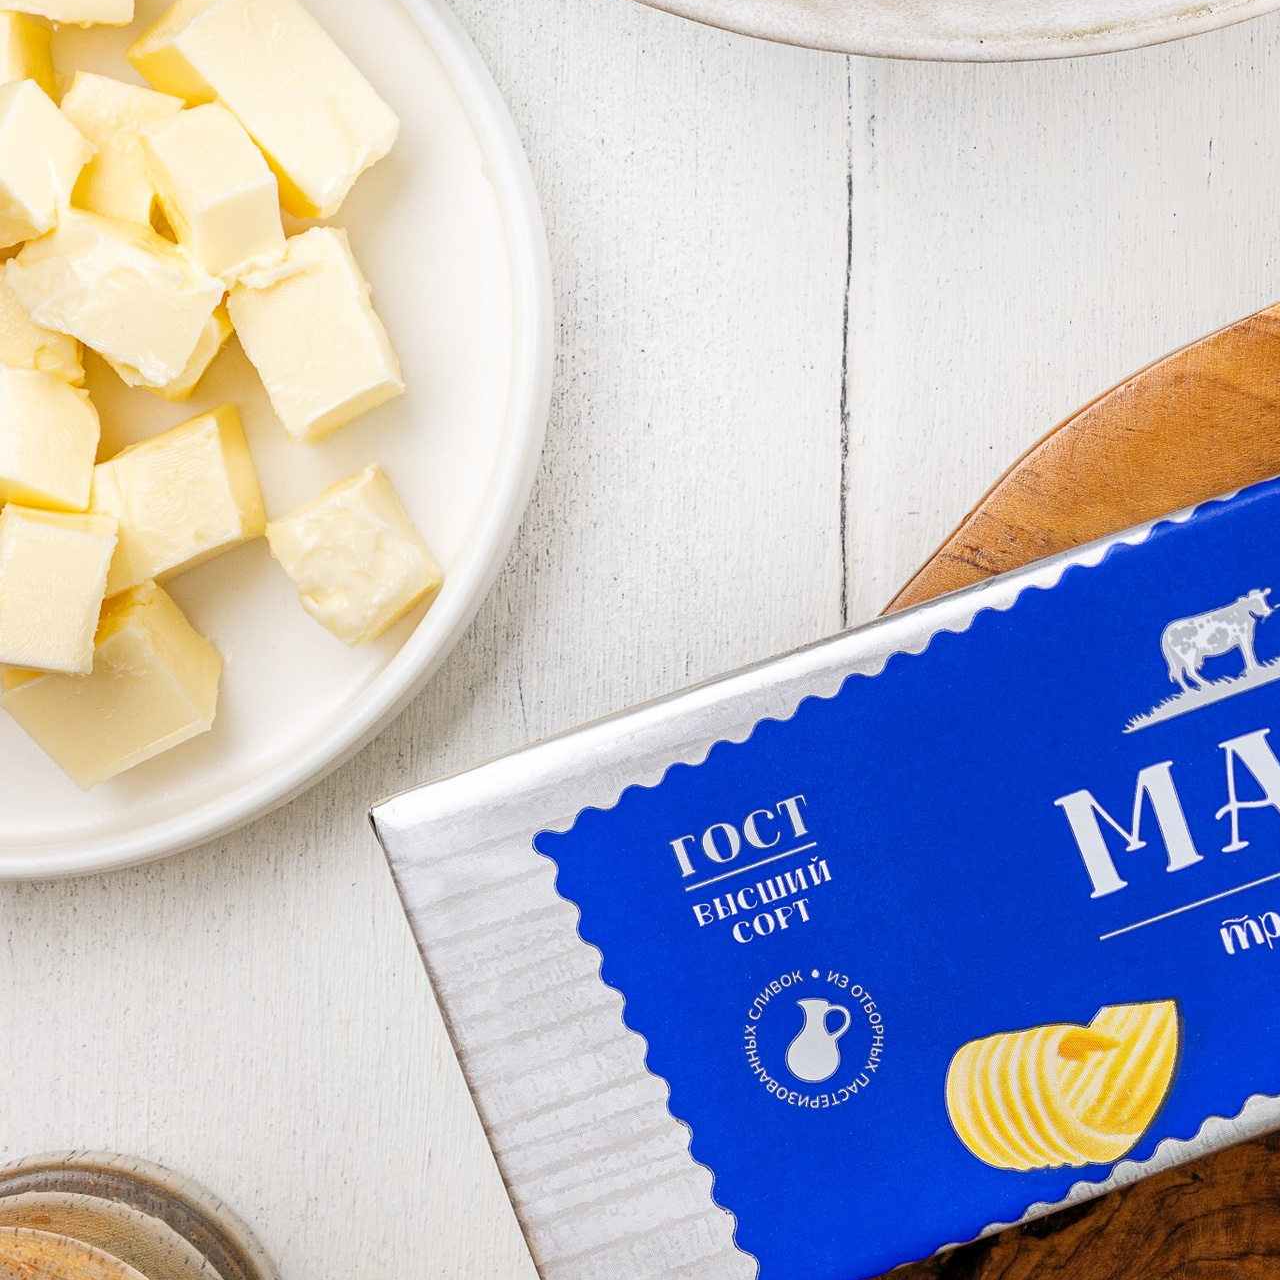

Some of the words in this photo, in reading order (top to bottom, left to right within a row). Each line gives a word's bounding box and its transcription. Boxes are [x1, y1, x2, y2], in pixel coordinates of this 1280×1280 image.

[669, 794, 809, 878] ГОСТ
[691, 855, 832, 927] ВЫСШИЙ
[732, 898, 811, 944] СОРТ
[748, 969, 804, 1021] СЛИВОК
[827, 969, 850, 989] ИЗ
[850, 984, 885, 1074] ОТБОРНЫХ
[743, 1023, 871, 1109] ПАСТЕРИЗОВАННЫХ
